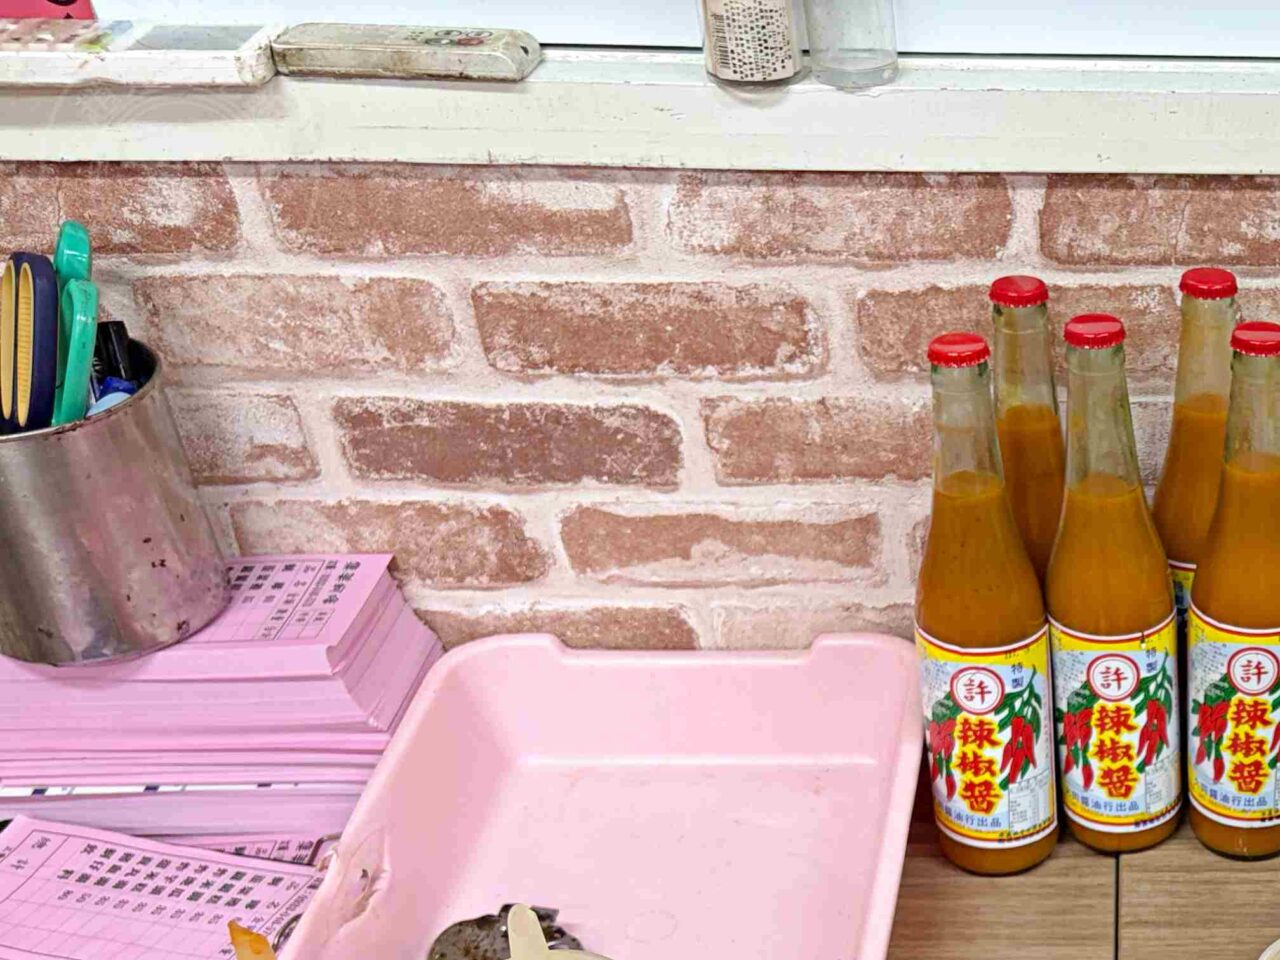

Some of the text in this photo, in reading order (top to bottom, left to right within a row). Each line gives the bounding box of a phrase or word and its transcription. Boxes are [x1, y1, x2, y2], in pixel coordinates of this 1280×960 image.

[963, 677, 993, 705] 許
[1099, 666, 1129, 692] 許
[1240, 659, 1269, 685] 許
[953, 716, 1001, 813] 辣椒醬
[1092, 704, 1138, 800] 辣椒醬
[1227, 696, 1274, 794] 辣椒醬
